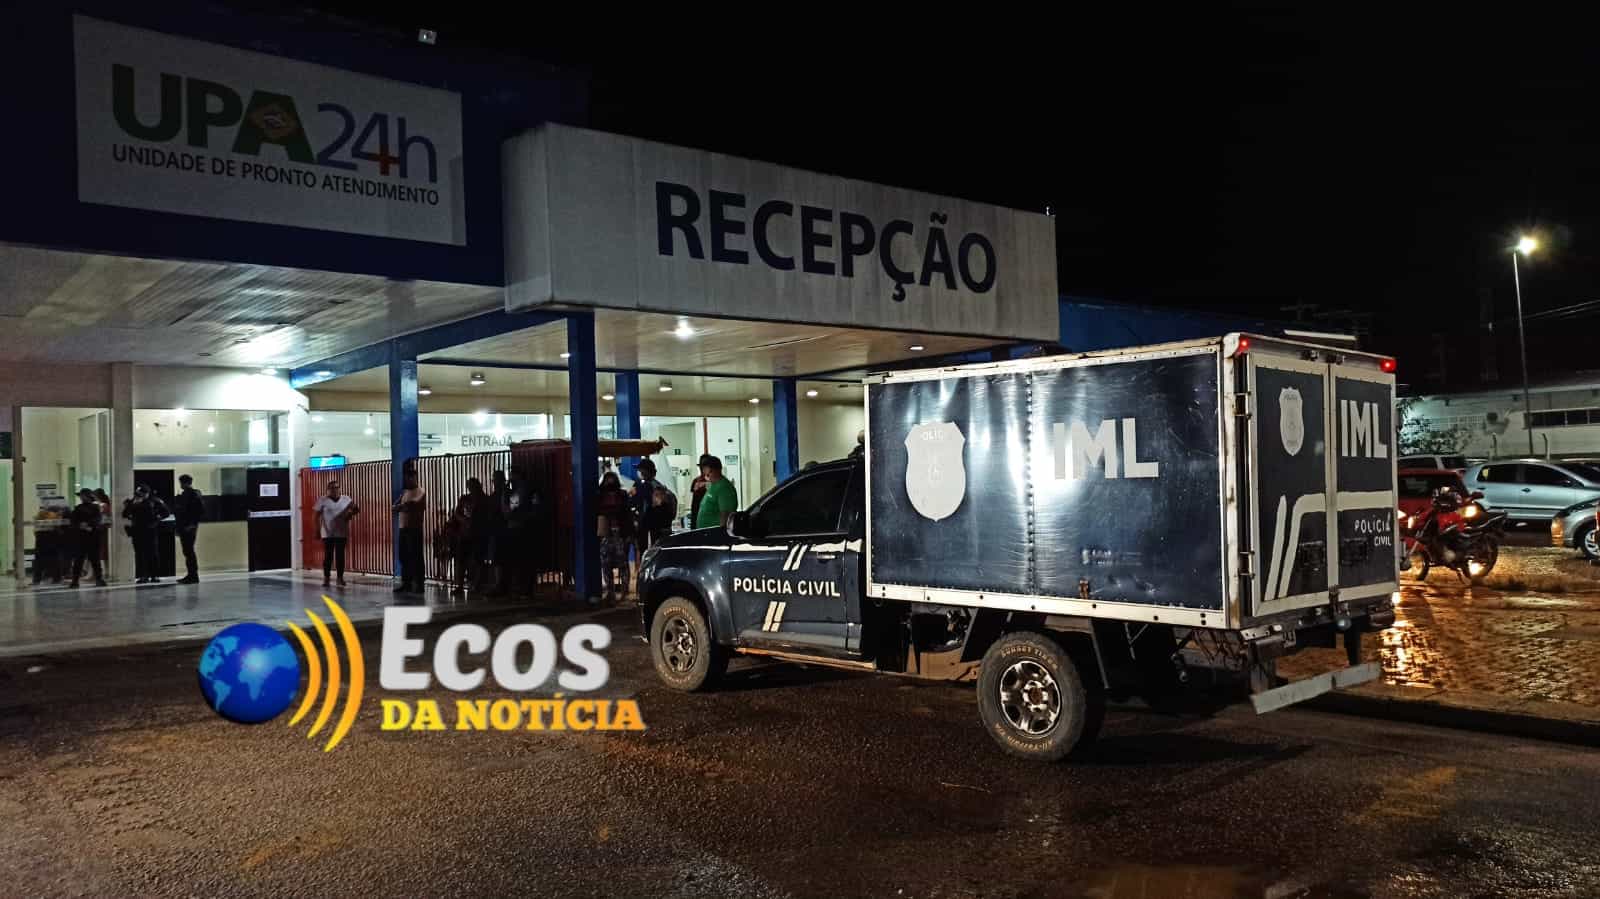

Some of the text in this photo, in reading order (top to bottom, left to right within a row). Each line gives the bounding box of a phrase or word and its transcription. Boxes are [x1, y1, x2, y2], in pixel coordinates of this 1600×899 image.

[111, 63, 438, 183] UPA 24h
[112, 143, 439, 206] UNIDADE DE PRONTO ATENDIMENTO
[655, 181, 997, 302] RECEPÇÃO
[1053, 417, 1160, 480] IML
[1340, 399, 1388, 458] IML
[1374, 535, 1392, 547] CIVIL
[733, 574, 841, 597] POLÍCIA CIVIL
